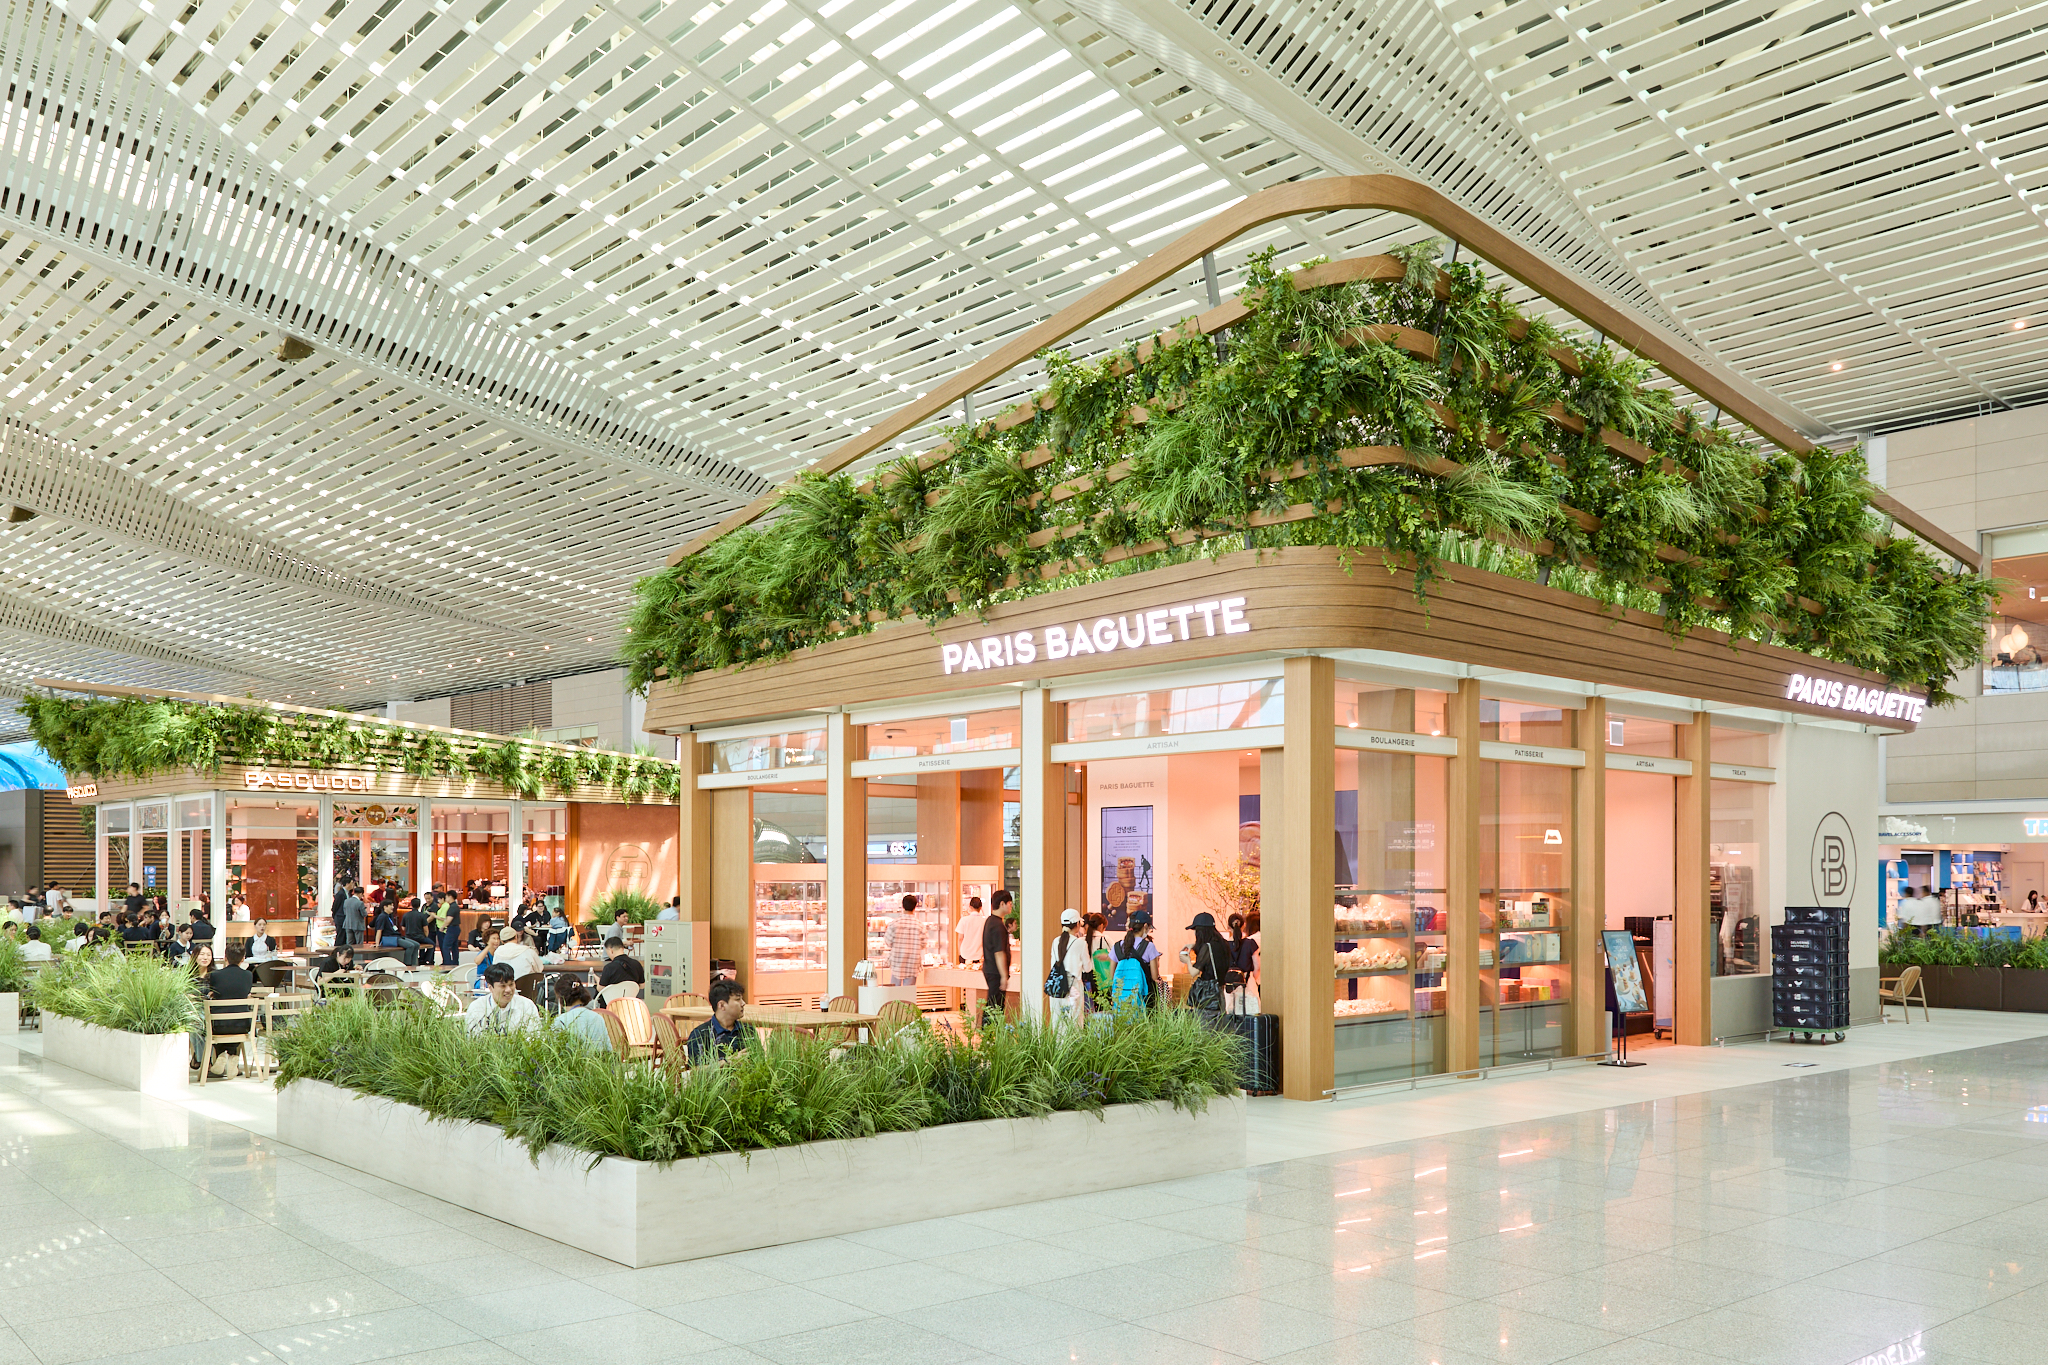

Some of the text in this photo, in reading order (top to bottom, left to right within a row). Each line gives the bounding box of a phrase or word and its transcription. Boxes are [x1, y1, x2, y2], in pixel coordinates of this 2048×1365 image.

[942, 597, 1250, 675] PARIS BAGUETTE
[1786, 673, 1926, 723] PARIS BAGUETTE
[1147, 740, 1179, 750] ARTISAN
[1370, 736, 1415, 747] BOULANGERIE
[1514, 749, 1544, 758] PATISSERIE
[918, 759, 951, 767] PATISSERIE
[1635, 760, 1655, 768] ARTISAN
[244, 771, 370, 790] PASCUCCI
[747, 773, 778, 781] BOULANGERIE
[1120, 781, 1155, 789] BAGUETTE
[1116, 825, 1138, 834] 안녕샌드
[889, 841, 918, 856] GS25
